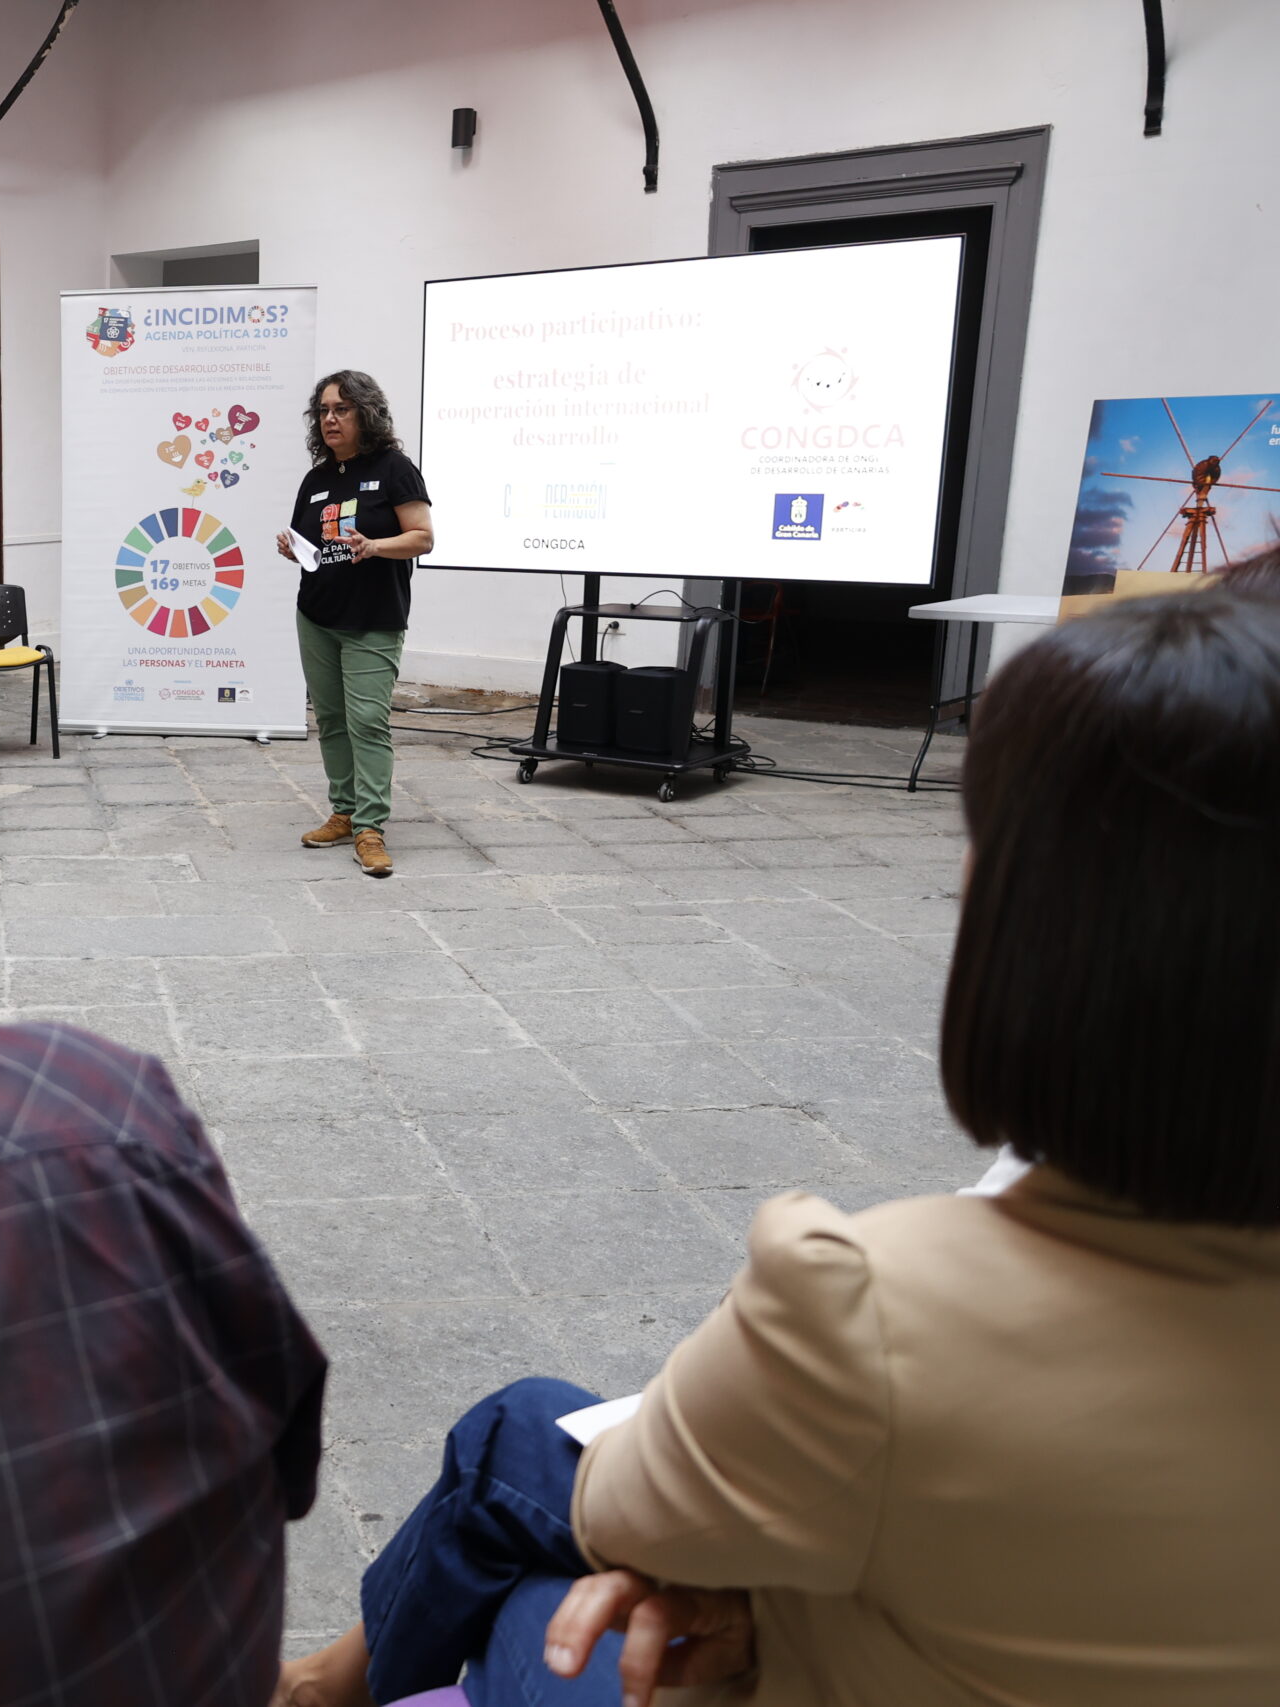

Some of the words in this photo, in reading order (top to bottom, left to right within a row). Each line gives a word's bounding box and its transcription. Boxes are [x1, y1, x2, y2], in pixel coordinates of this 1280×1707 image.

[144, 305, 289, 326] ¿INCIDIMOS?
[449, 320, 535, 342] Proceso
[540, 306, 703, 342] participativo:
[145, 331, 193, 341] AGENDA
[197, 328, 250, 340] POLÍTICA
[253, 328, 288, 338] 2030
[103, 366, 147, 375] OBJETIVOS
[149, 365, 161, 374] DE
[163, 364, 218, 374] DESARROLLO
[219, 362, 271, 373] SOSTENIBLE
[493, 363, 609, 391] estrategia
[617, 361, 647, 385] de
[437, 398, 558, 424] cooperación
[563, 393, 711, 417] internacional
[512, 425, 619, 447] desarrollo
[741, 424, 905, 449] CONGDCA
[759, 455, 835, 464] COORDINADORA
[838, 455, 850, 463] DE
[751, 467, 761, 475] DE
[764, 467, 823, 475] DESARROLLO
[841, 467, 890, 475] CANARIAS
[523, 538, 585, 550] CONGDCA
[150, 560, 170, 574] 17
[151, 577, 179, 591] 169
[128, 647, 147, 655] UNA
[148, 647, 212, 655] OPORTUNIDAD
[122, 659, 138, 667] LAS
[139, 659, 186, 667] PERSONAS
[206, 660, 245, 668] PLANETA
